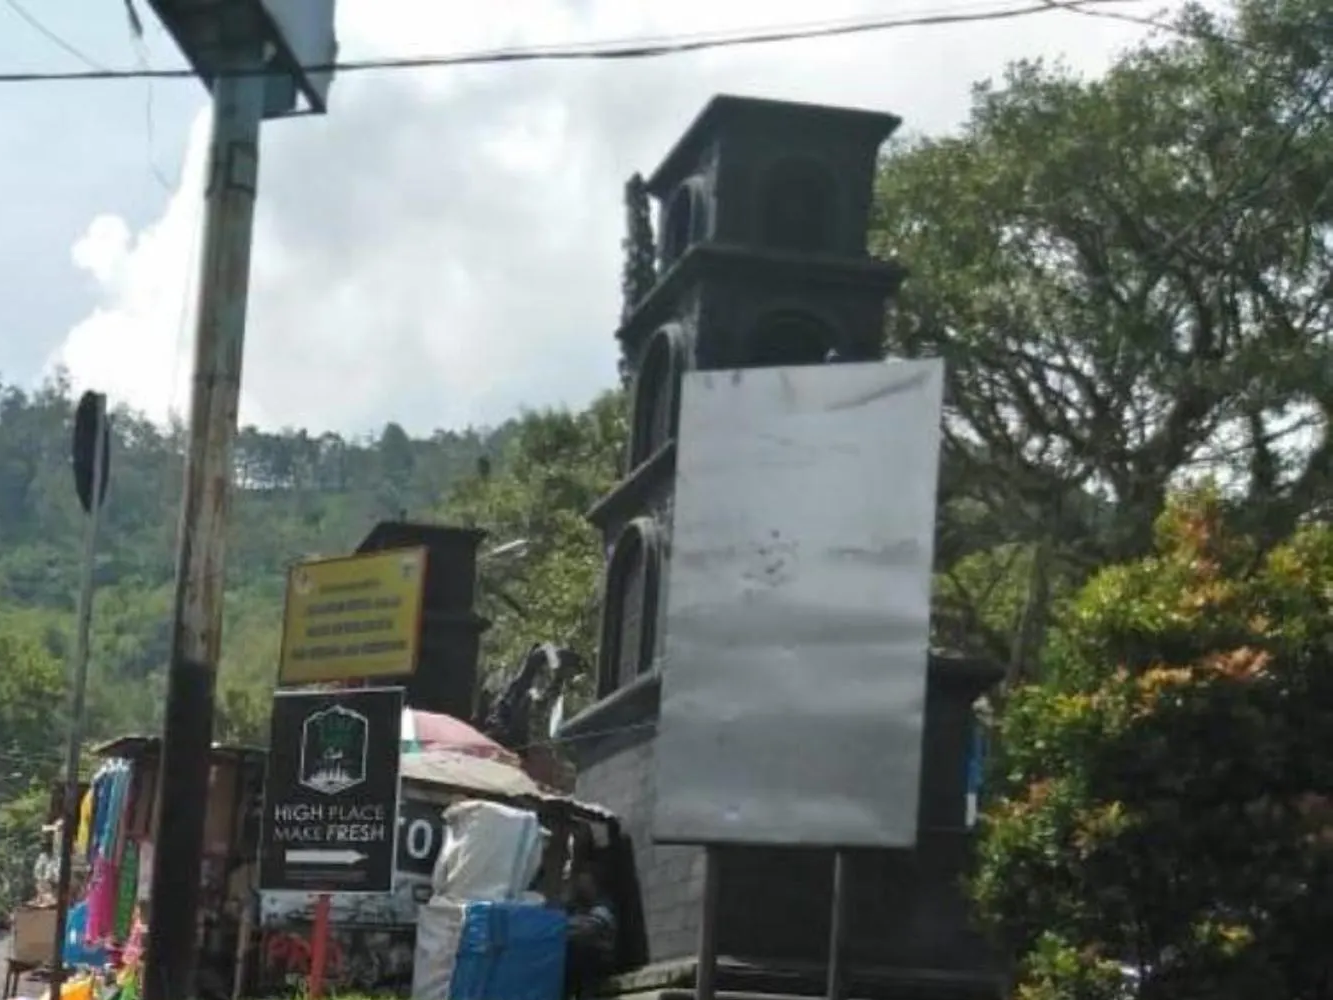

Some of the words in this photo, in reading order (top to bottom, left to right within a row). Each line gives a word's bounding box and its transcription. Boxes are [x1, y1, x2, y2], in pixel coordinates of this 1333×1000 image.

[274, 803, 323, 821] HIGH
[328, 804, 385, 821] PLACE
[273, 825, 322, 842] MAKE
[325, 824, 385, 842] FRESH
